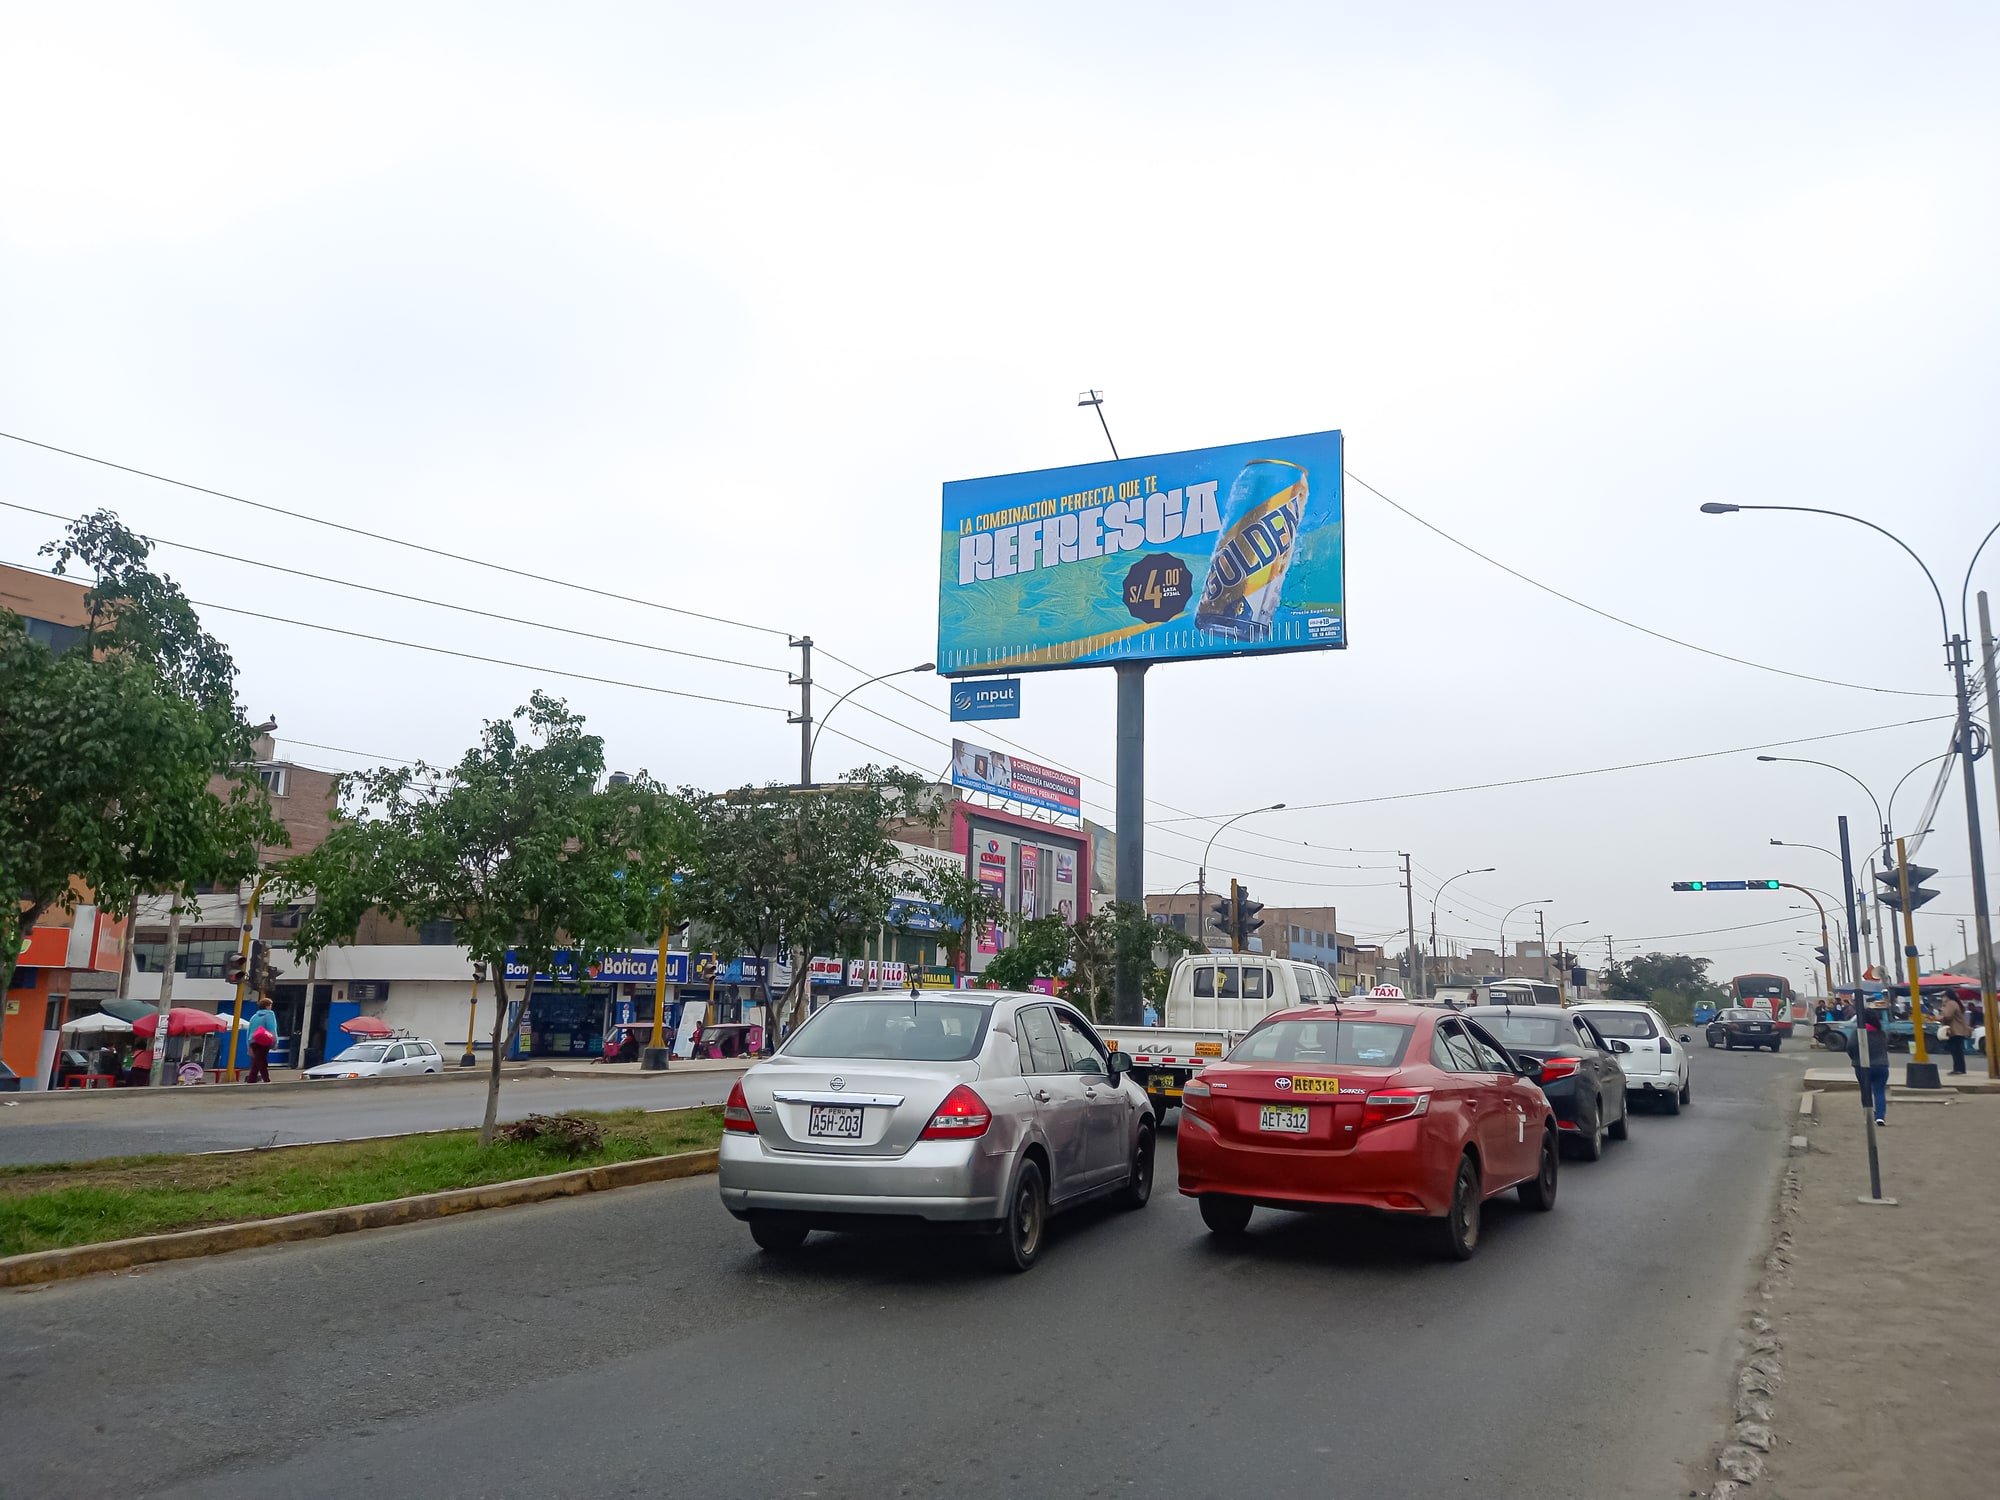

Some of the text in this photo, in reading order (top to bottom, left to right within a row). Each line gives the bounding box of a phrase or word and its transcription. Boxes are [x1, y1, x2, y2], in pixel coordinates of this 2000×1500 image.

[959, 476, 1157, 535] LA COMBINACIÓN PERFECTA QUE TE
[958, 480, 1222, 586] REFRESCA
[1205, 498, 1299, 601] GOLDEN
[942, 648, 978, 668] TOMAR
[987, 643, 1037, 664] BEBIDAS
[1046, 635, 1131, 660] ALCOHÓLICAS
[1141, 632, 1155, 652] EN
[1166, 627, 1214, 650] EXCESO
[1224, 625, 1238, 646] ES
[976, 688, 1014, 702] input
[1016, 760, 1076, 785] CHEQUEOS GINECOLÓGICOS
[1016, 783, 1060, 801] CONTROL PRENATAL
[604, 957, 678, 976] Botica Aul
[1374, 988, 1398, 997] TAXI
[812, 1114, 860, 1132] A5H-203
[1261, 1111, 1307, 1130] AET-312
